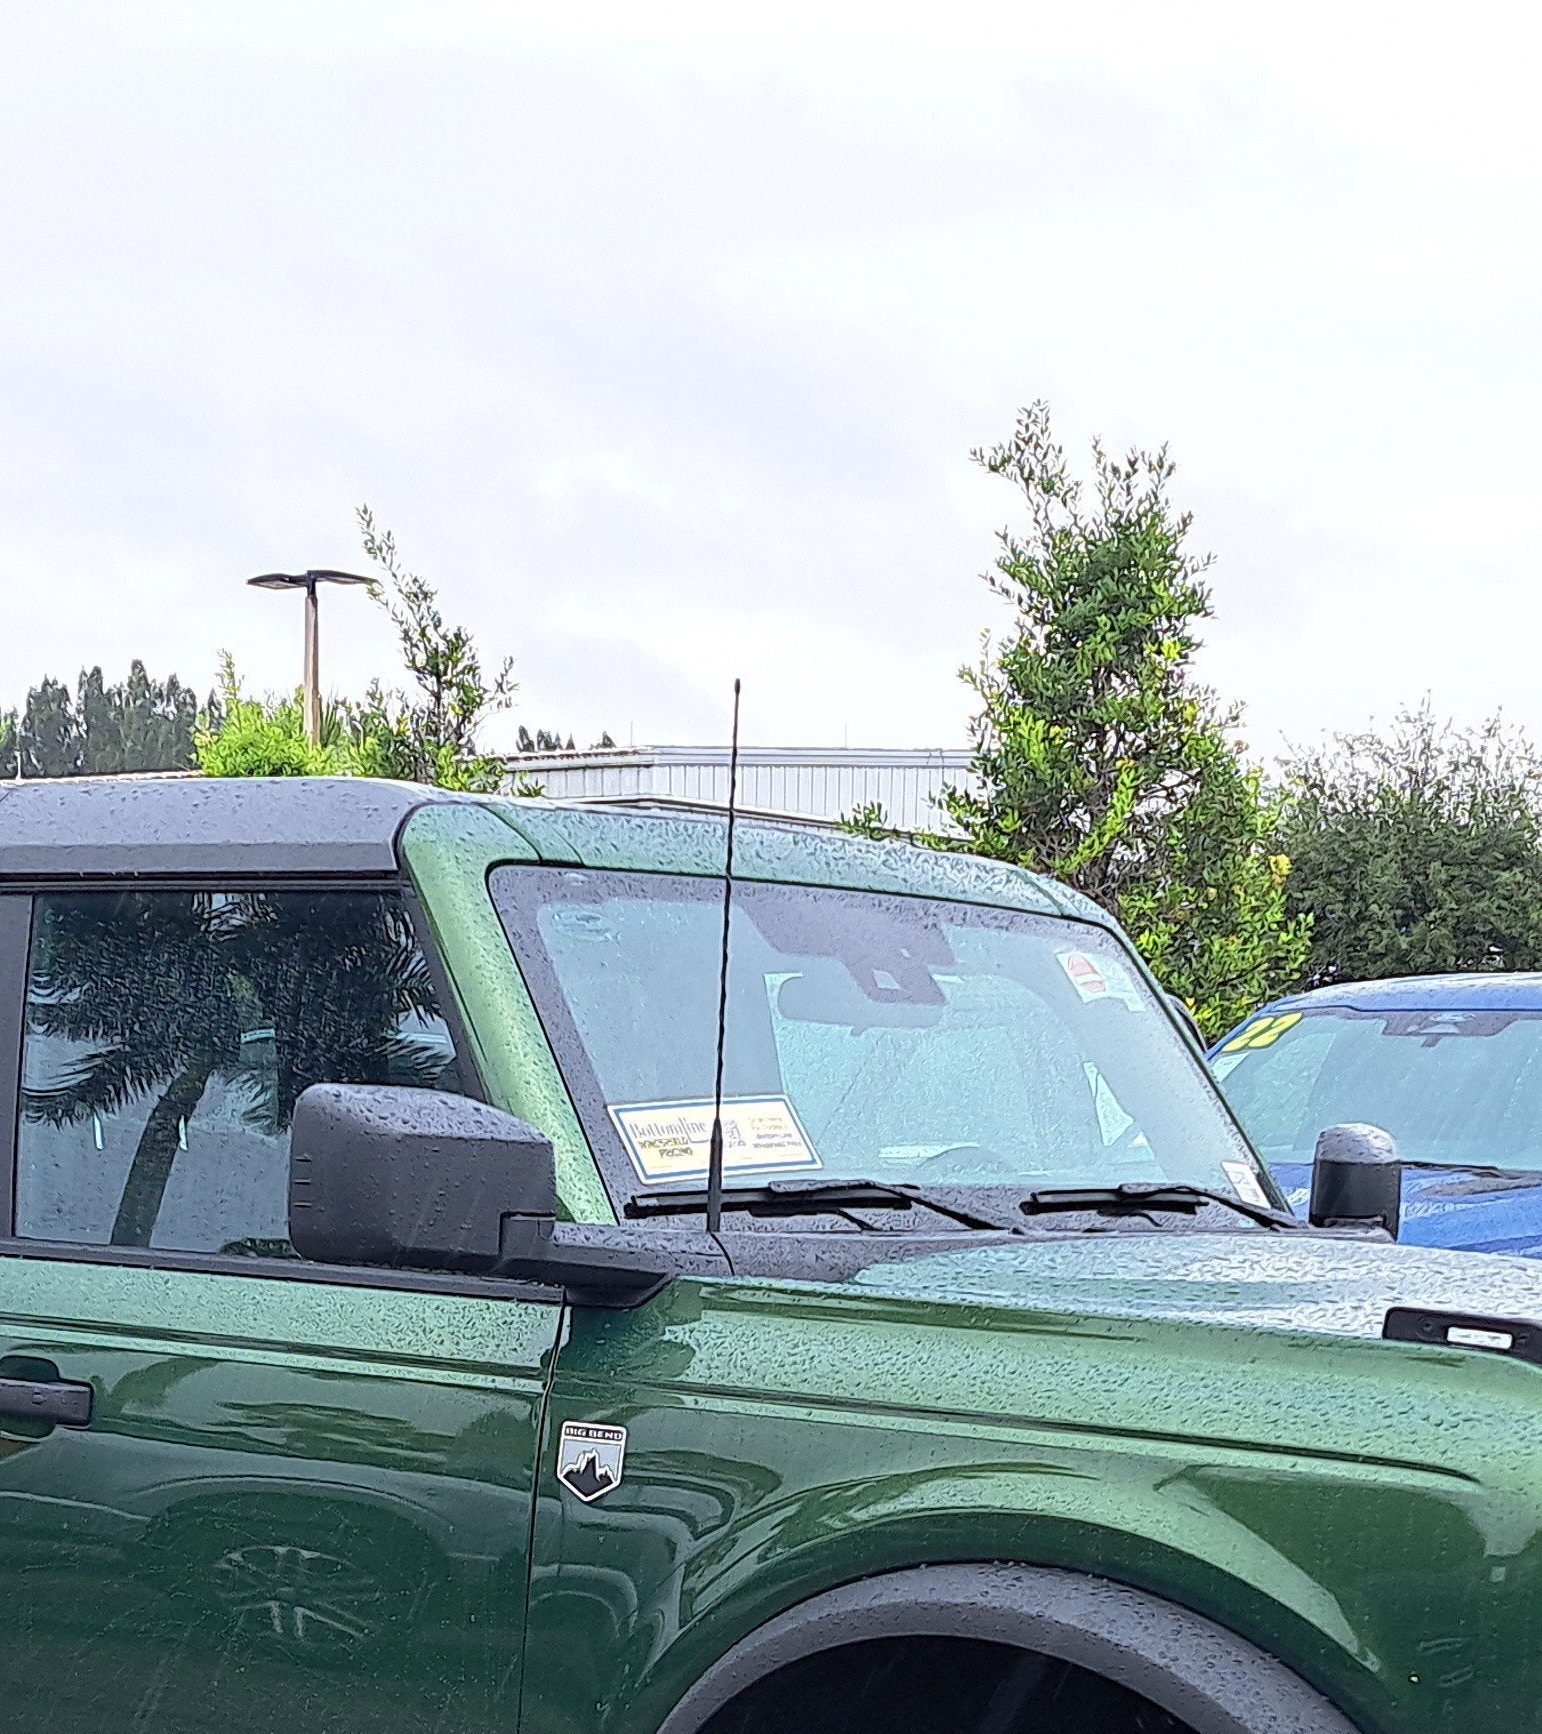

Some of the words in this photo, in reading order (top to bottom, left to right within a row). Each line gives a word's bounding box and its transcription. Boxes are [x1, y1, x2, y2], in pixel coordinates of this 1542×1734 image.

[1221, 1012, 1303, 1053] 22
[565, 1427, 587, 1438] BIG
[589, 1430, 623, 1441] BEND
